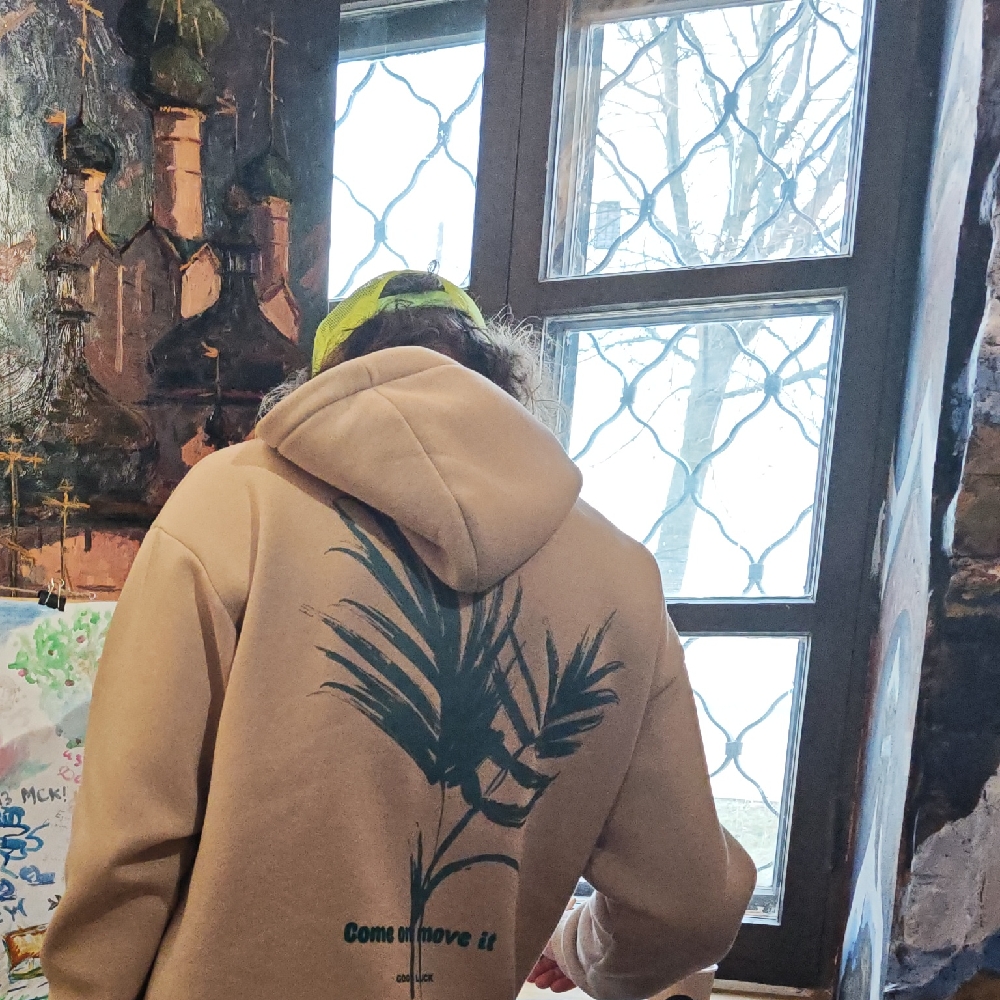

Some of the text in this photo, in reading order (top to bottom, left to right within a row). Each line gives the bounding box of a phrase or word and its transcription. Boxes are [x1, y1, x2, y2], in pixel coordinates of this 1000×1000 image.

[344, 922, 394, 943] Come
[417, 925, 472, 947] move
[477, 931, 497, 951] it
[396, 974, 414, 983] GOO
